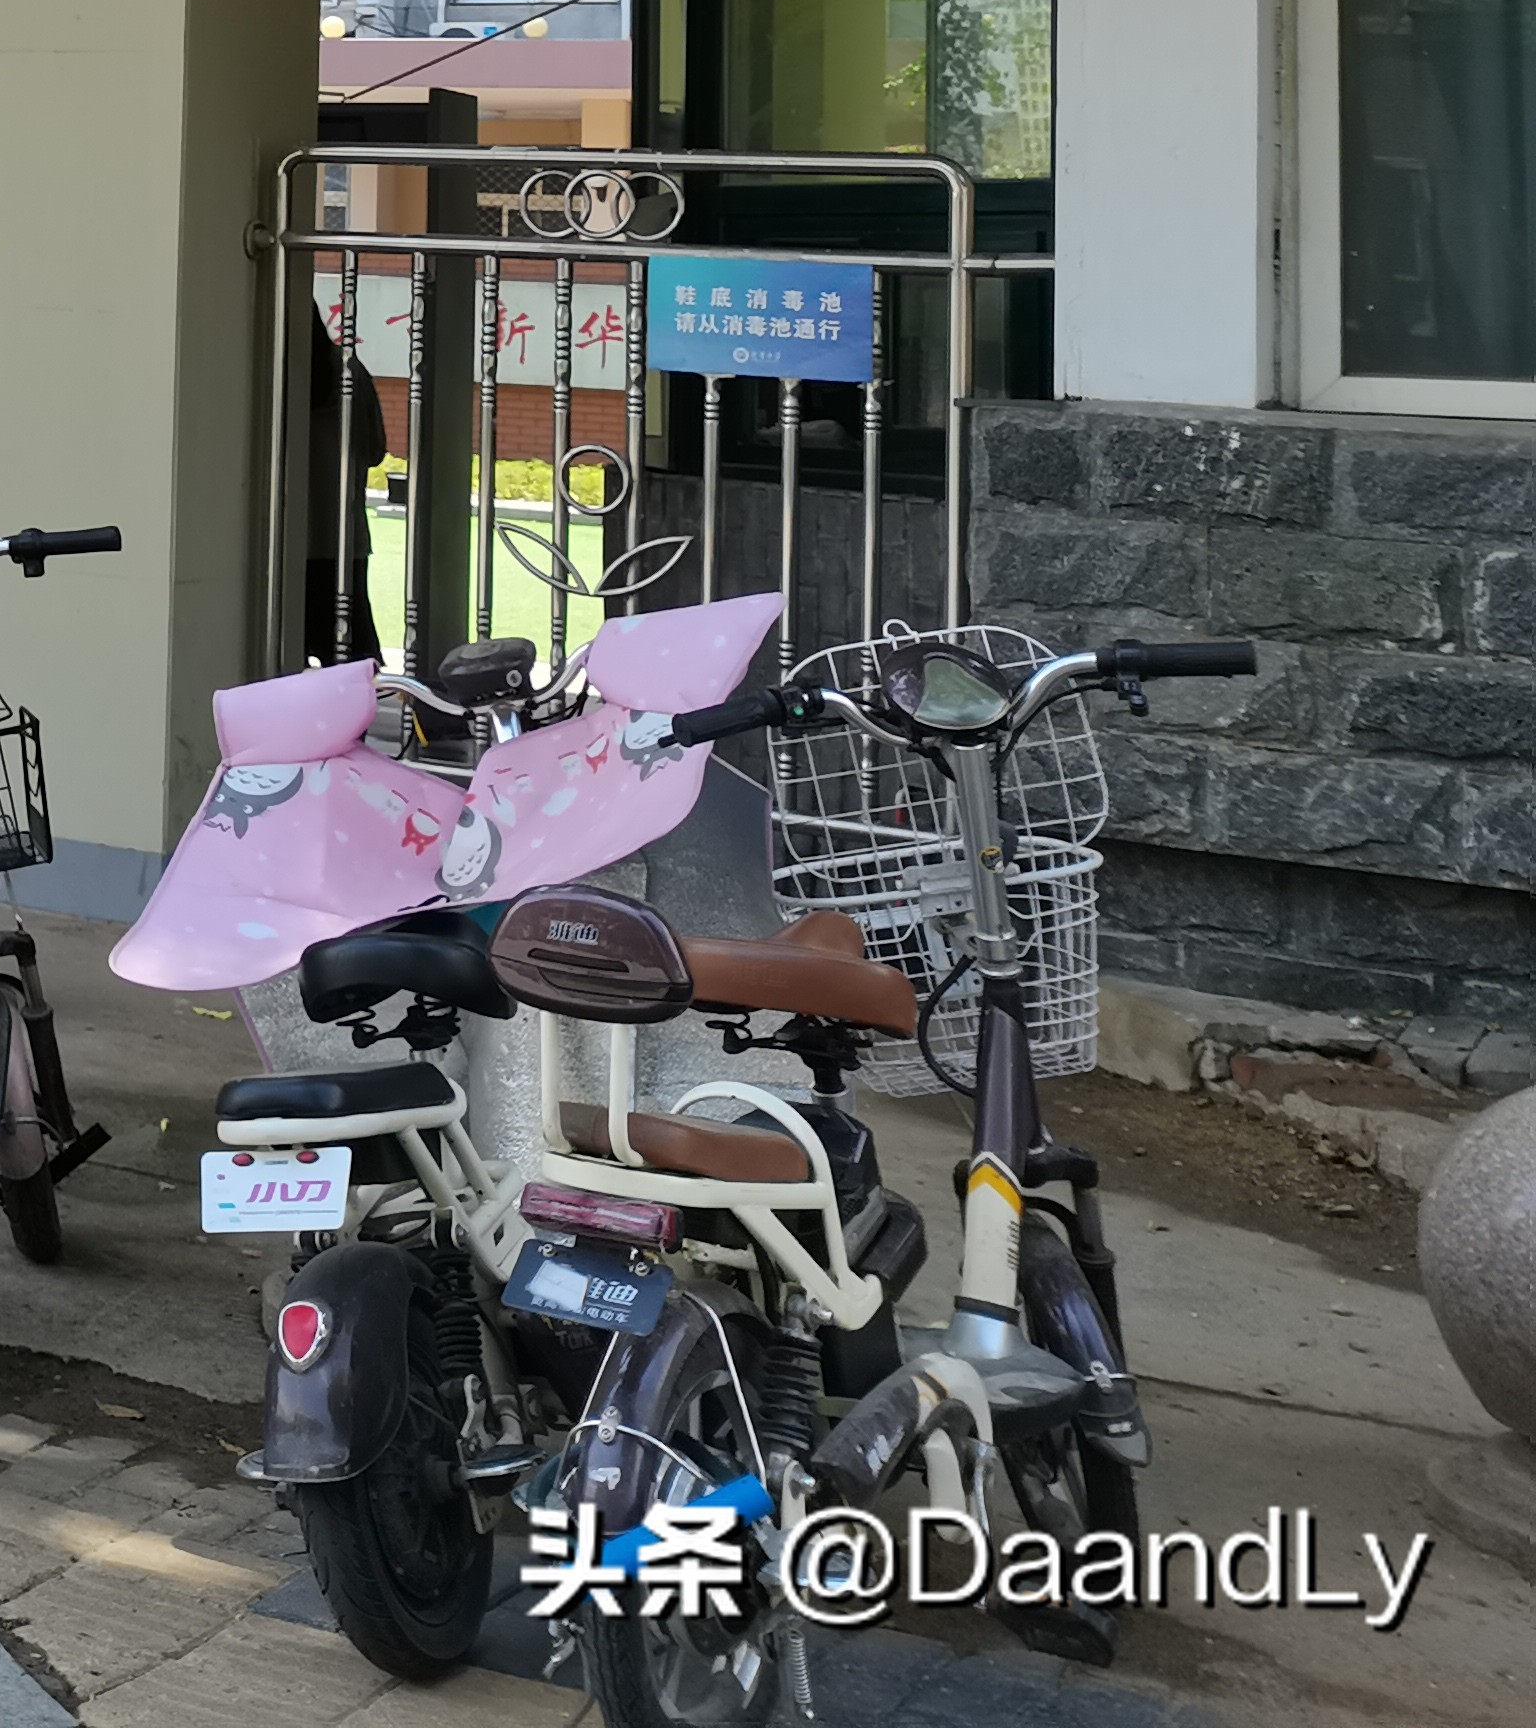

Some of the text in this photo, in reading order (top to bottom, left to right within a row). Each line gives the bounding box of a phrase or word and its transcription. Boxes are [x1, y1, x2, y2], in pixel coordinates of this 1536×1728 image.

[674, 284, 843, 314] 鞋底消毒池
[674, 311, 842, 341] 请从消毒池通行
